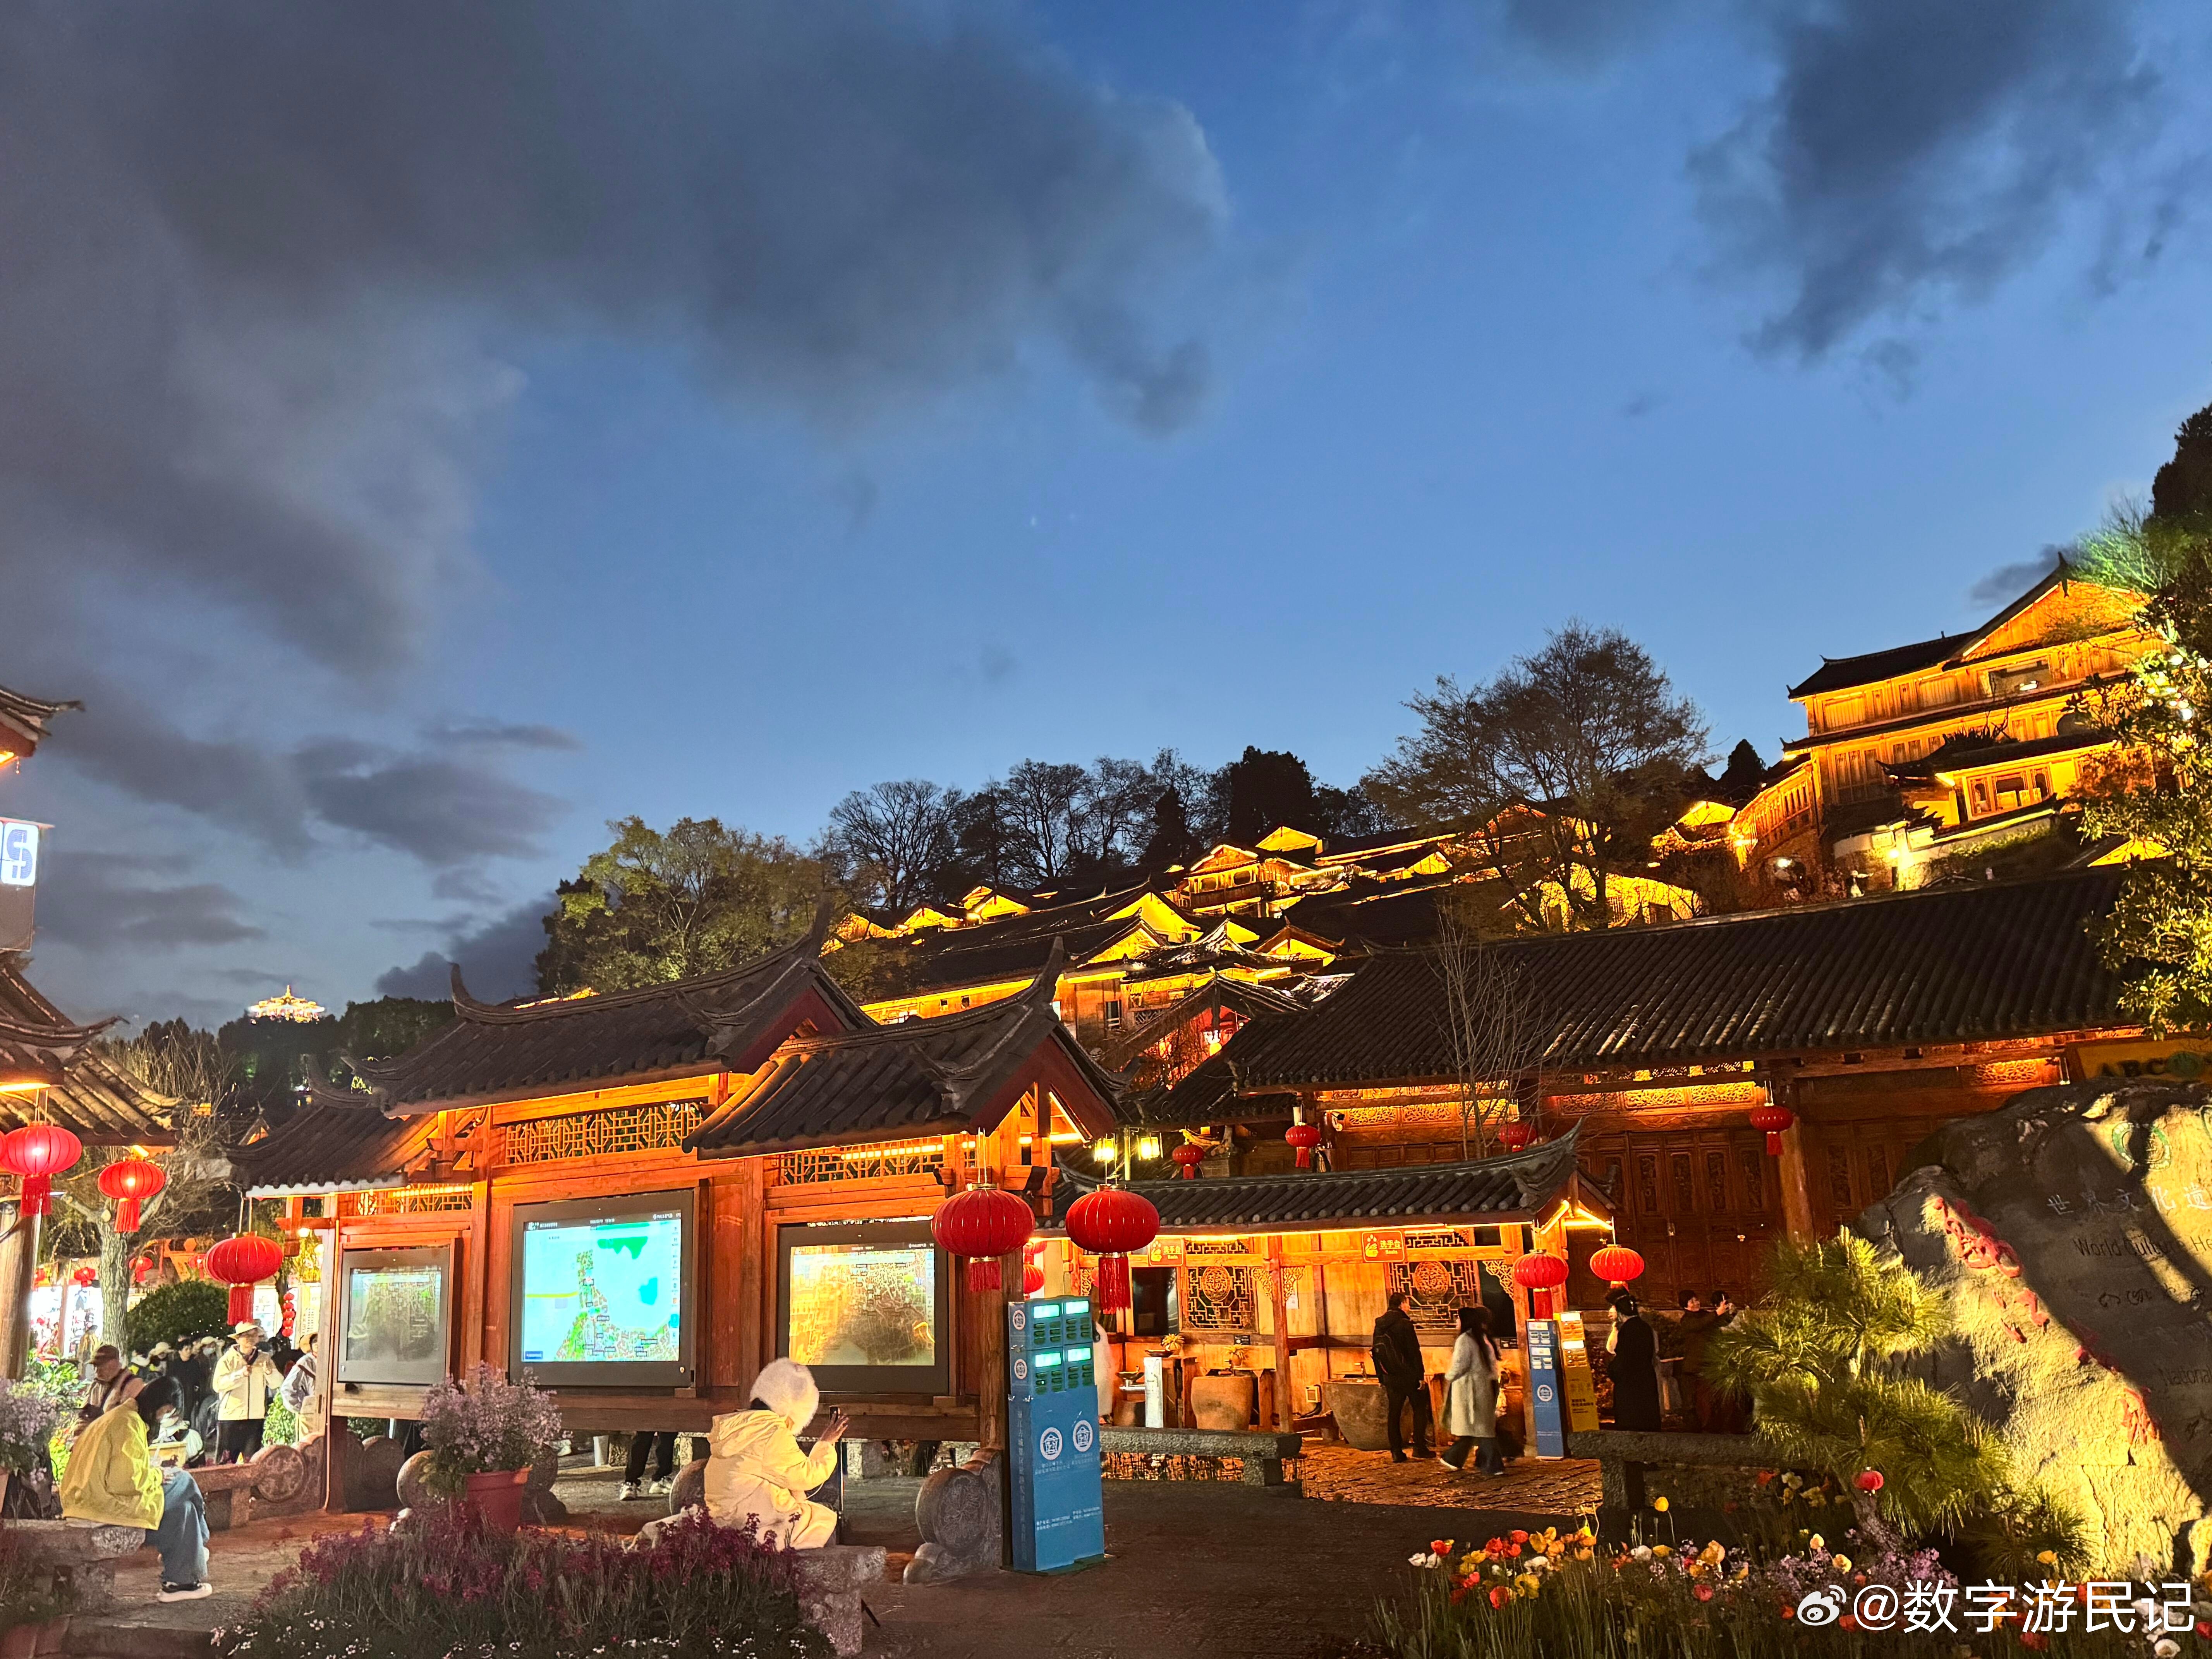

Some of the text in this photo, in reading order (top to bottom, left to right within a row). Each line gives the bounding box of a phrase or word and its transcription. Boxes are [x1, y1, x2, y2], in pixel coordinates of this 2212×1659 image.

[1380, 1239, 1401, 1248] 洗手台
[2073, 1237, 2122, 1257] World
[2123, 1235, 2185, 1257] Cultu
